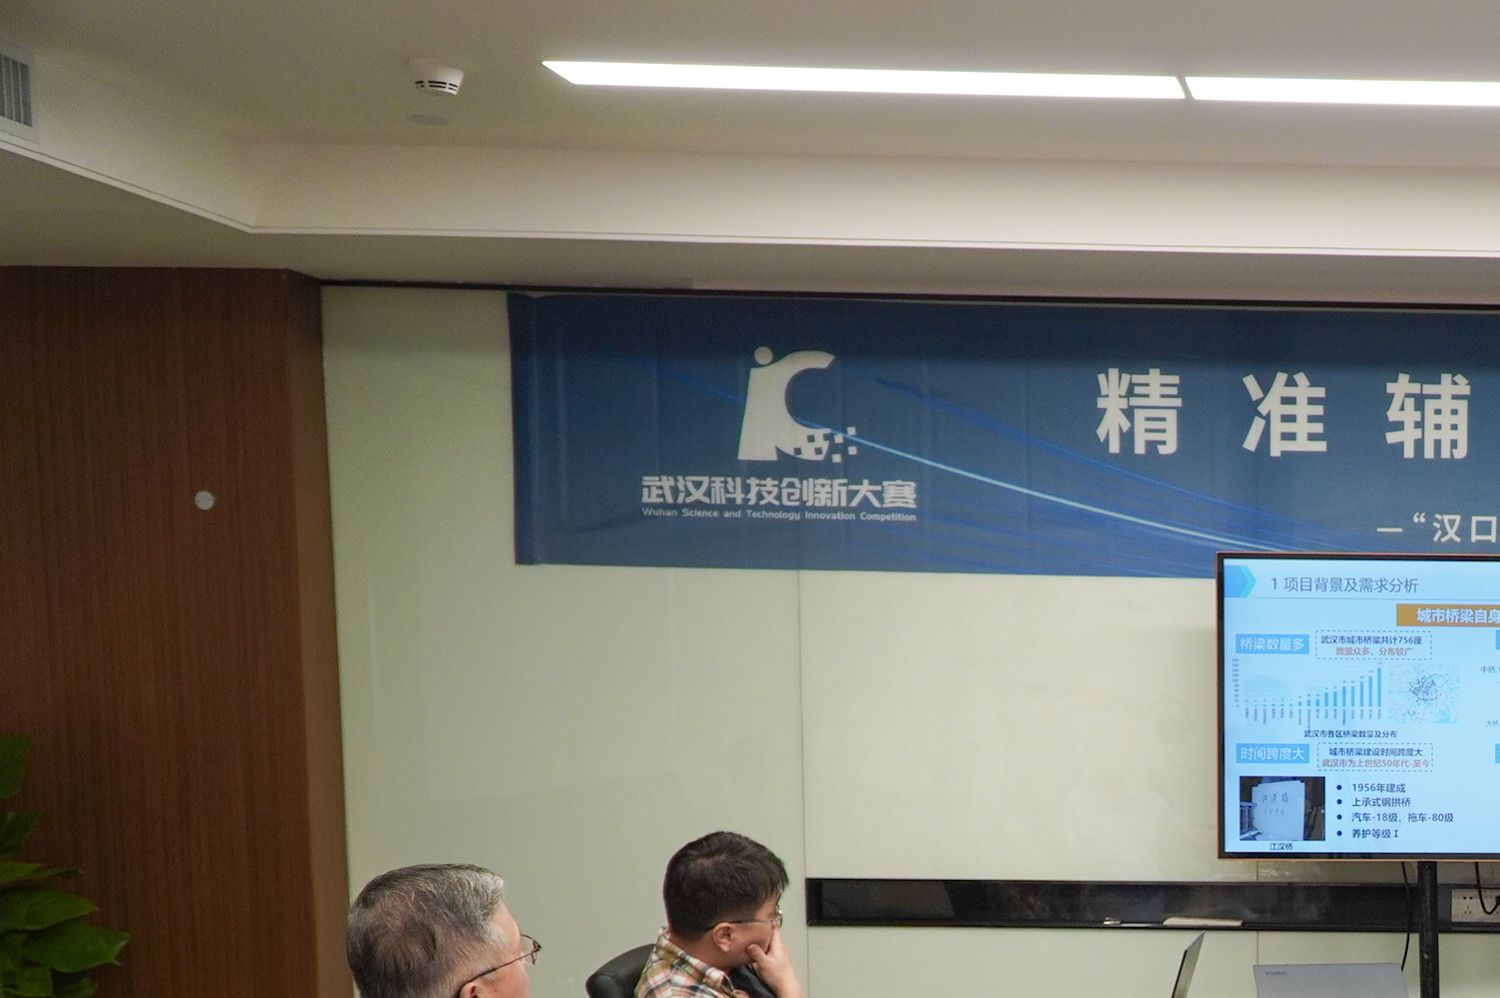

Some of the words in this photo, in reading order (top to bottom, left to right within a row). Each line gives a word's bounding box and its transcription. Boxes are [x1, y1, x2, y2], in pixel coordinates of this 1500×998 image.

[641, 475, 917, 508] 武汉科技创新大赛
[642, 507, 677, 518] Wuhan
[682, 508, 719, 518] Science
[724, 509, 741, 518] and
[746, 510, 800, 520] Technology
[805, 511, 855, 520] Innovation
[860, 511, 917, 522] Competition
[1271, 577, 1278, 590] 1
[1283, 577, 1419, 593] 项目背景及需求分析
[1239, 637, 1305, 652] 桥梁数量多
[1240, 746, 1305, 761] 时间跨度大
[1352, 783, 1406, 793] 1956年建成
